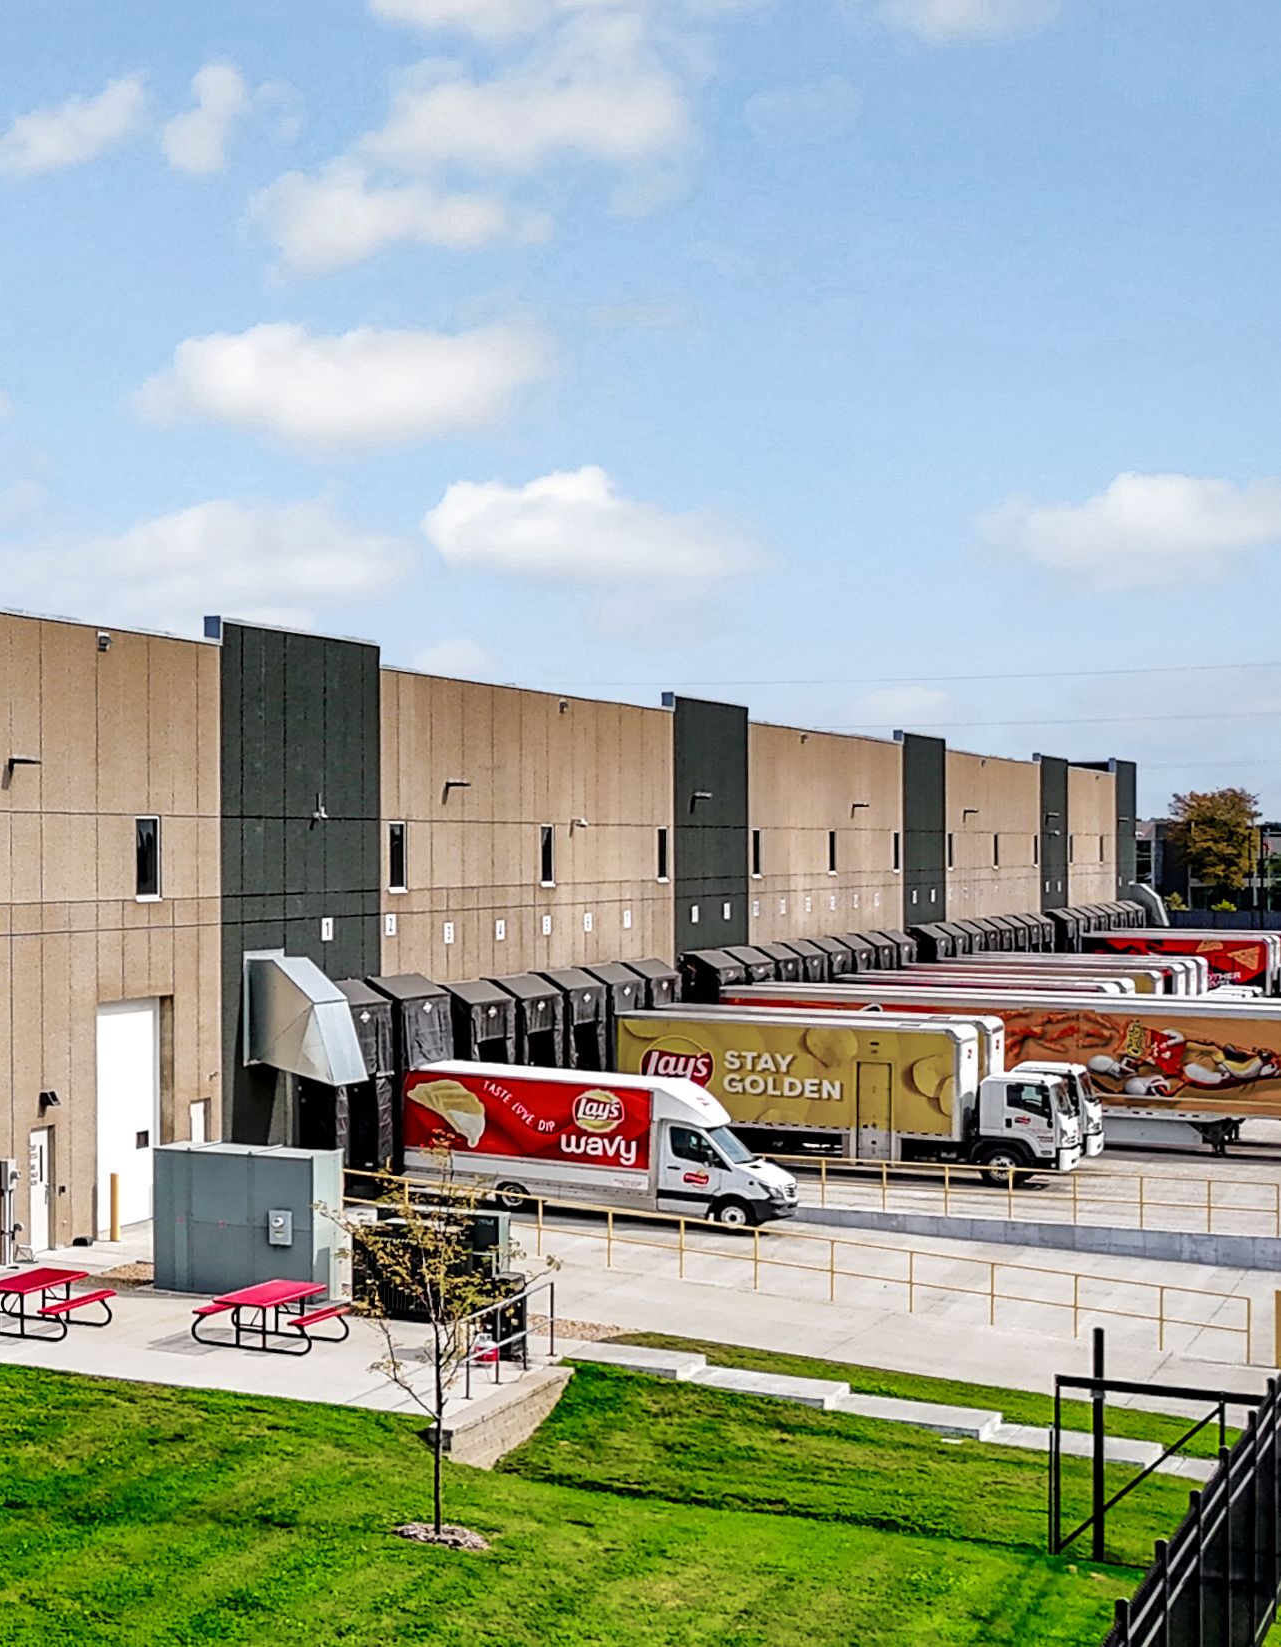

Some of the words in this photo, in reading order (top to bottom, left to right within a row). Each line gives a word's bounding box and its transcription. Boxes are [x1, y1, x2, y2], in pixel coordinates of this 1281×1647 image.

[723, 1050, 794, 1073] STAY
[723, 1073, 842, 1100] GOLDEN
[577, 1098, 620, 1120] Lay's
[560, 1133, 637, 1166] wavy
